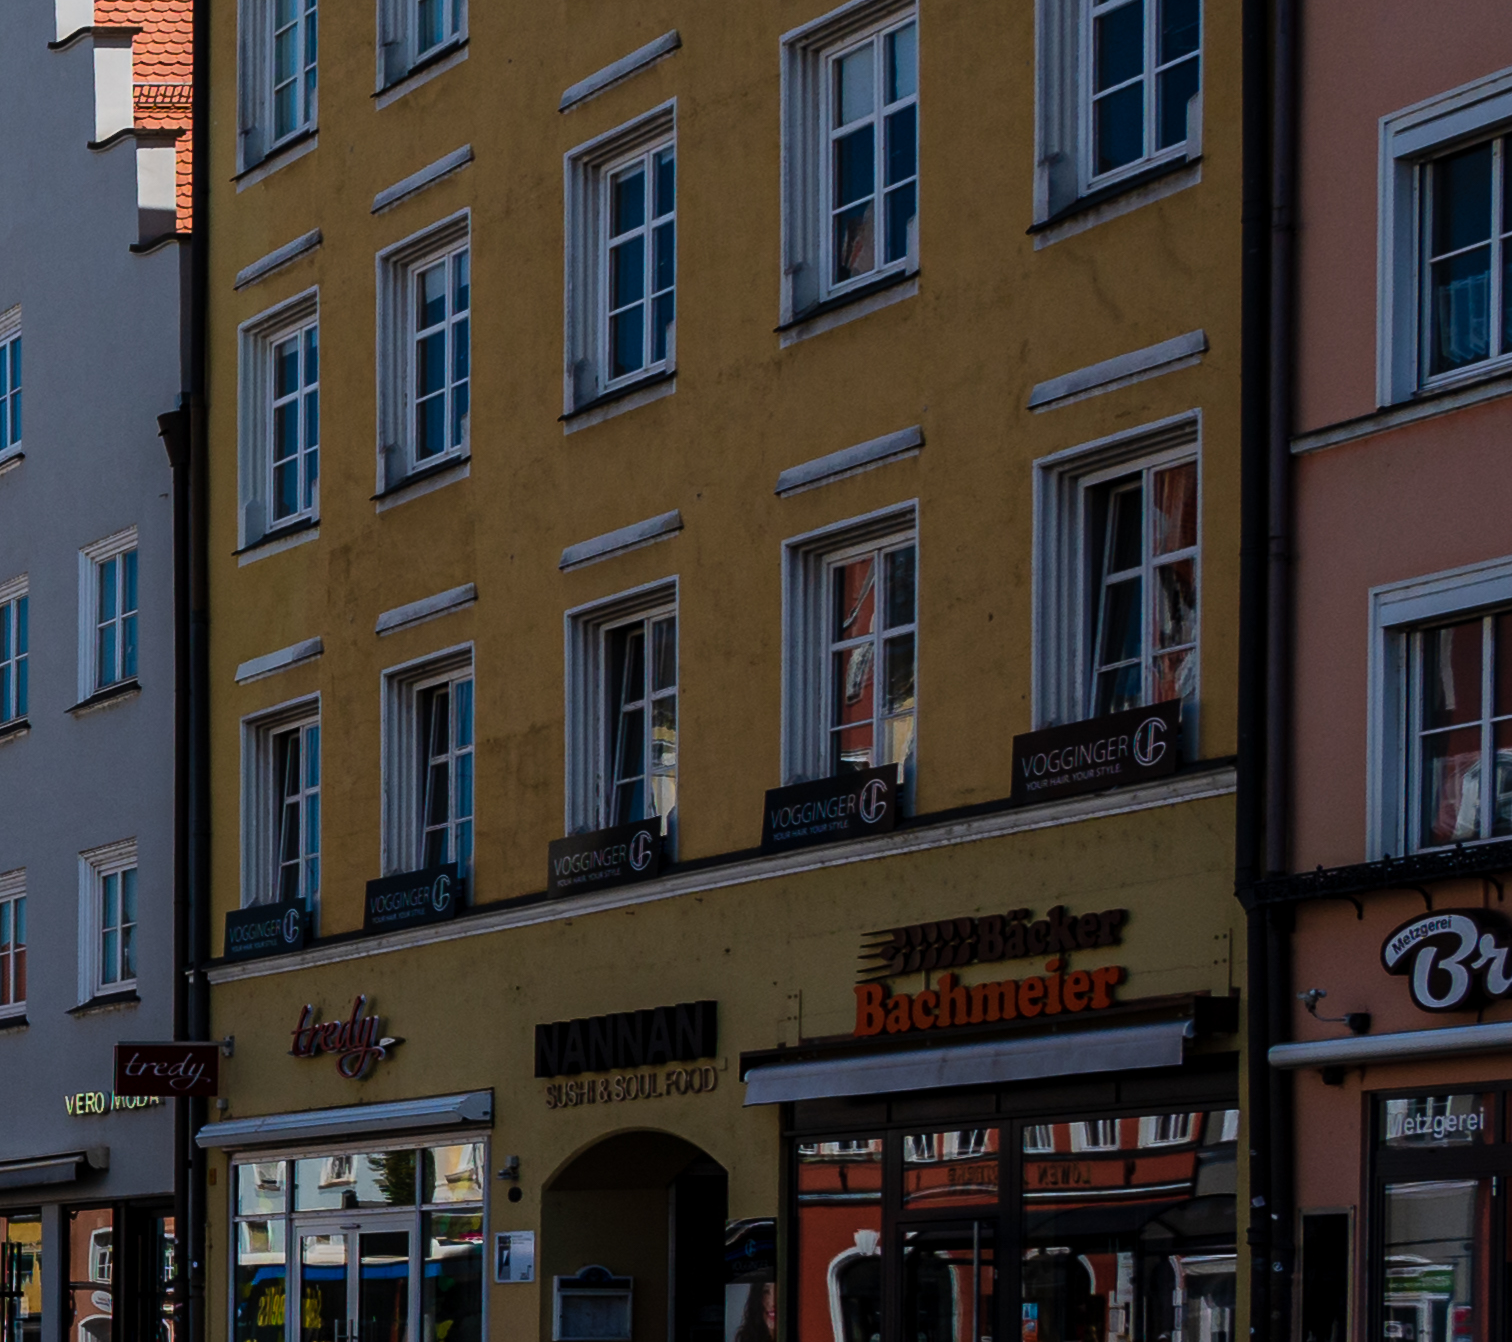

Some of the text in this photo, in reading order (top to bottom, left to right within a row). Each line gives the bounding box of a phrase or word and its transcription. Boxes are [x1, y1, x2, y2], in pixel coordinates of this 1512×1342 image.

[1021, 735, 1129, 778] VOGGINGER
[1025, 778, 1049, 792] YOUR
[1072, 768, 1094, 781] YOUR
[770, 793, 857, 829] VOGGINGER
[553, 844, 627, 876] VOGGINGER
[369, 886, 430, 913] VOGGINGER
[229, 919, 282, 943] VOGGINGER
[977, 905, 1126, 961] Bäcker
[1391, 915, 1453, 955] Metzgerei
[853, 959, 1126, 1038] Bachmeier
[290, 994, 386, 1079] tredy
[535, 1000, 717, 1077] NANNAN
[123, 1051, 212, 1091] tredy
[546, 1066, 718, 1108] SUSHI & SOUL FOOD
[64, 1091, 105, 1115] VERO
[1389, 1107, 1485, 1139] Metzgerei
